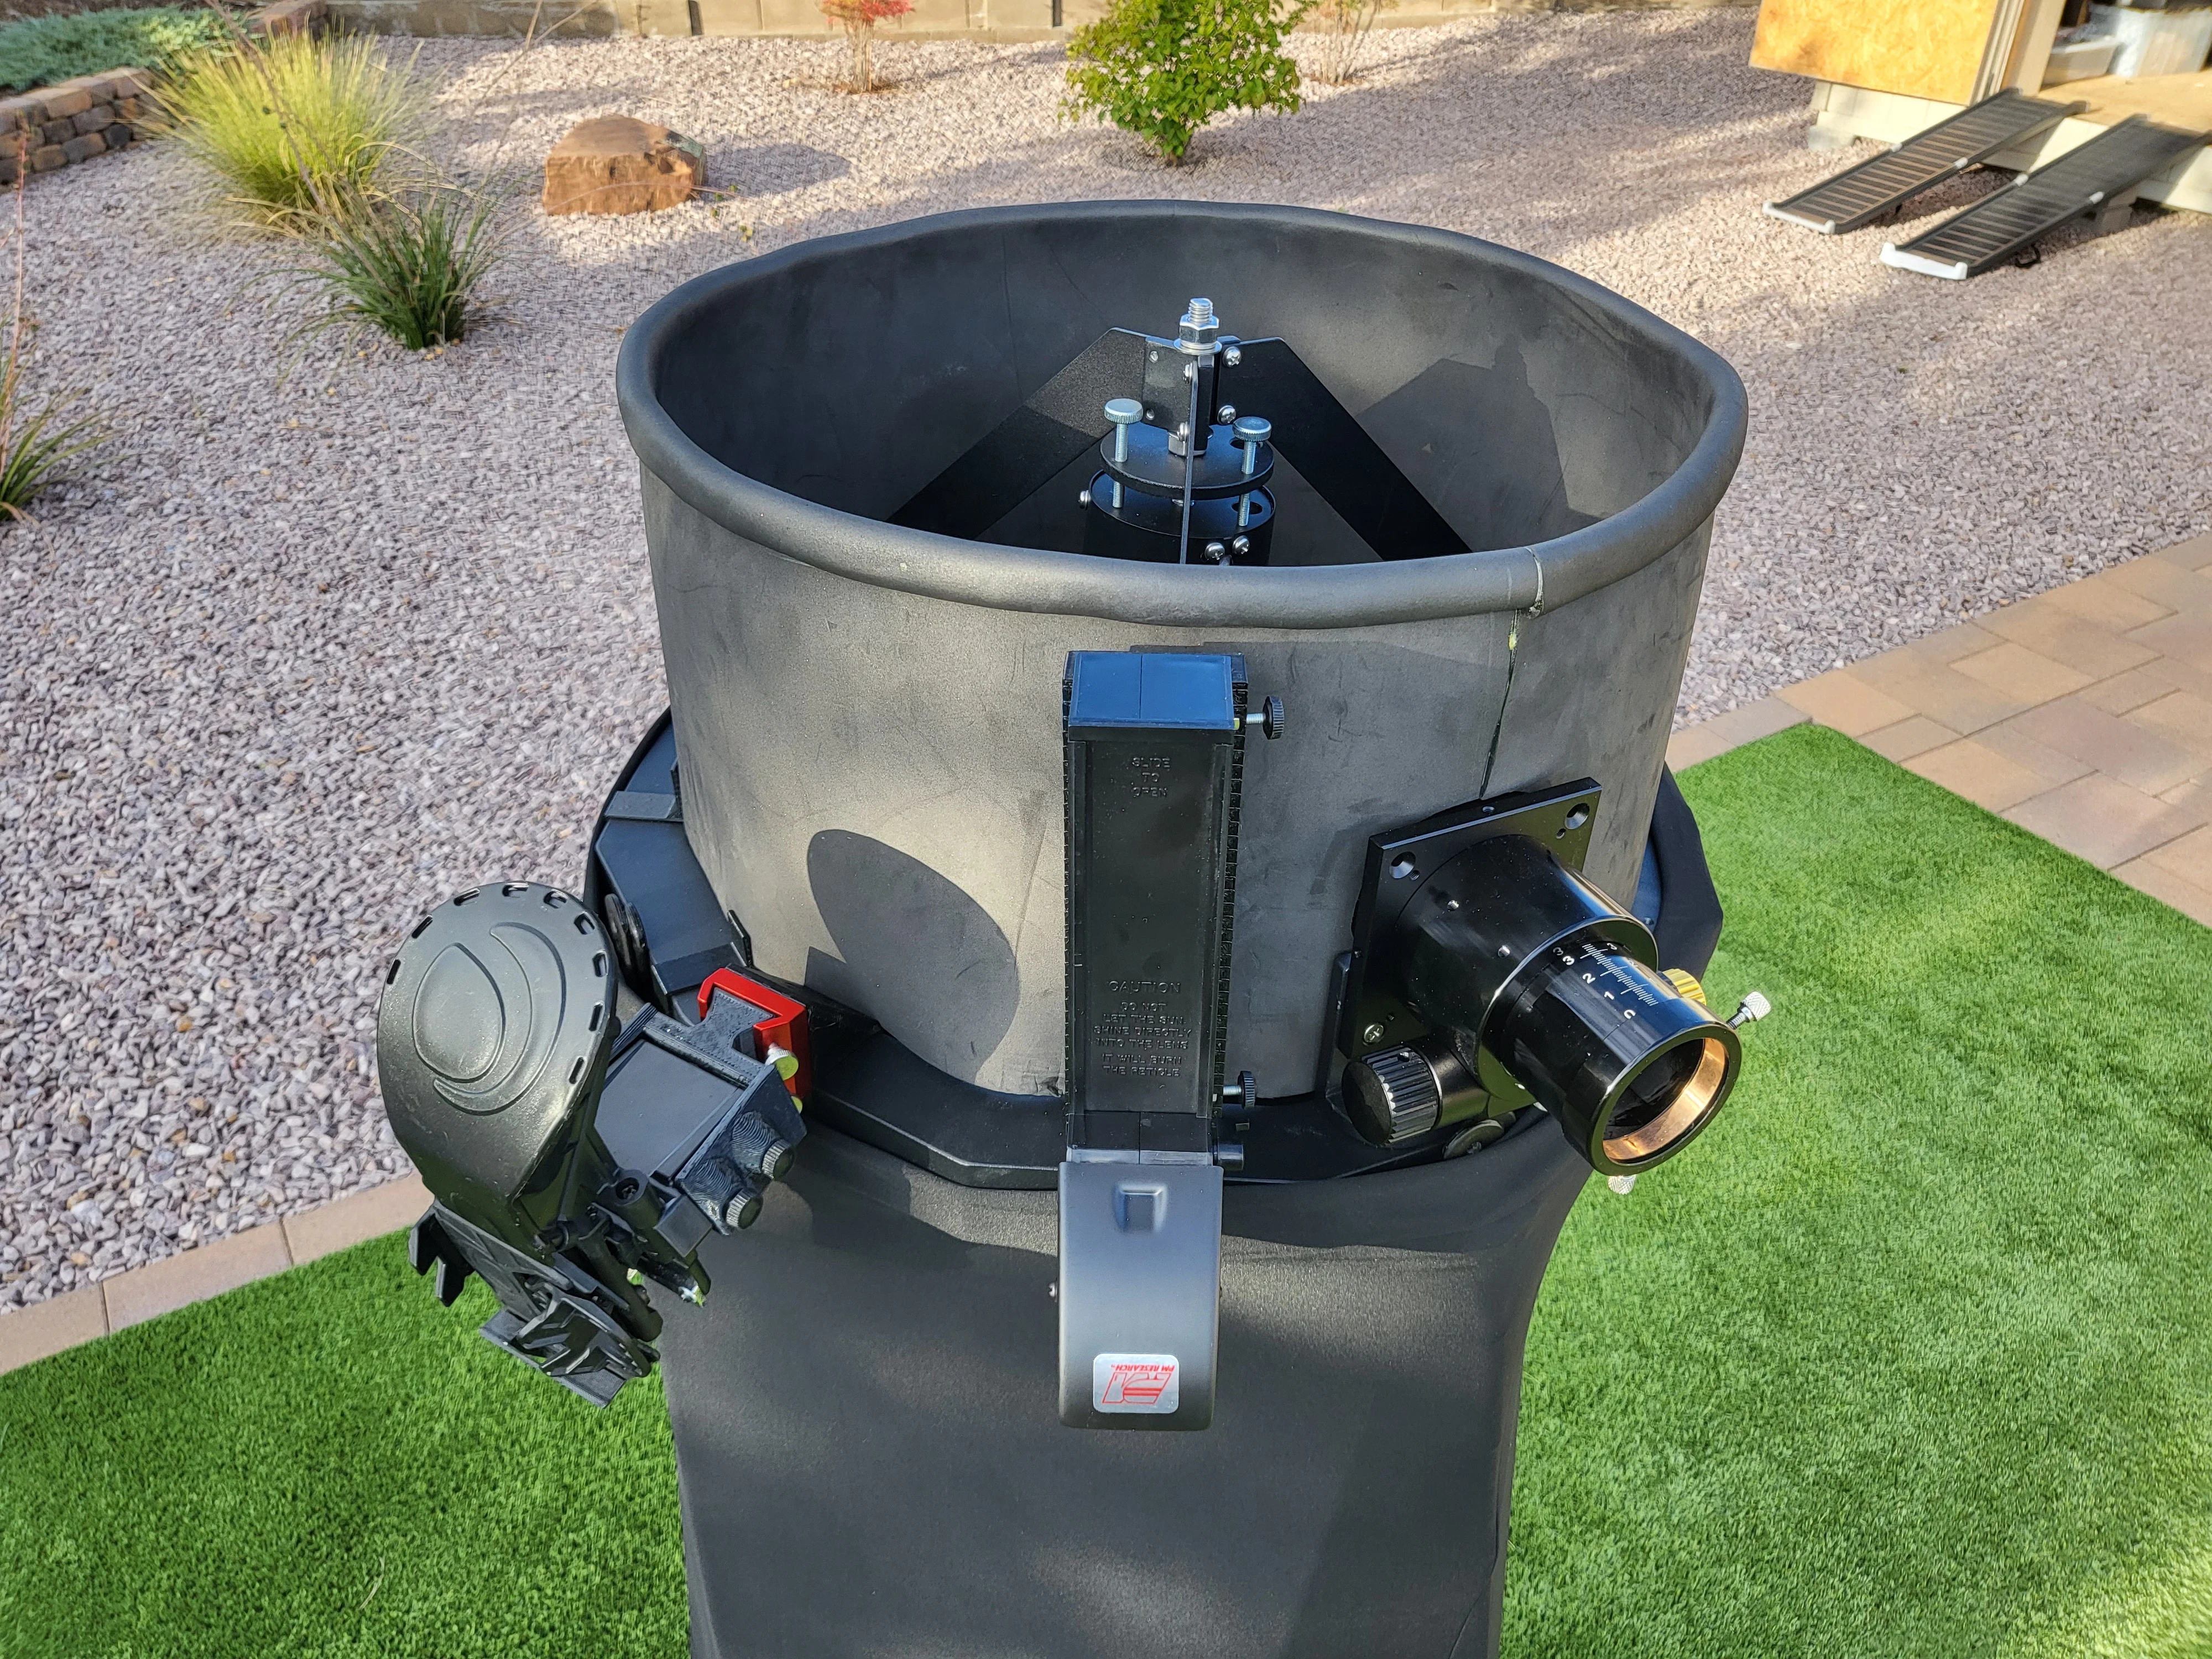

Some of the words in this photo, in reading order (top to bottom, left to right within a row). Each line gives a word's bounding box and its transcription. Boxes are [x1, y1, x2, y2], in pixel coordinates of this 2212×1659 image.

[1131, 757, 1171, 768] SLIDE
[1141, 772, 1160, 782] TO
[1131, 787, 1168, 797] OPEN
[1563, 956, 1575, 966] 3
[1583, 973, 1595, 984] 2
[1604, 991, 1615, 1000] 1
[1109, 980, 1181, 993] CAUTION
[1121, 1002, 1136, 1011] DO
[1142, 1003, 1167, 1011] NOT
[1103, 1014, 1126, 1023] LET
[1130, 1014, 1154, 1024] THE
[1093, 1026, 1130, 1036] SHINE
[1135, 1027, 1192, 1037] DIRECTLY
[1096, 1038, 1125, 1047] INTO
[1129, 1039, 1152, 1048] THE
[1102, 1053, 1113, 1062] IT
[1118, 1055, 1145, 1063] WILL
[1103, 1066, 1126, 1075] THE
